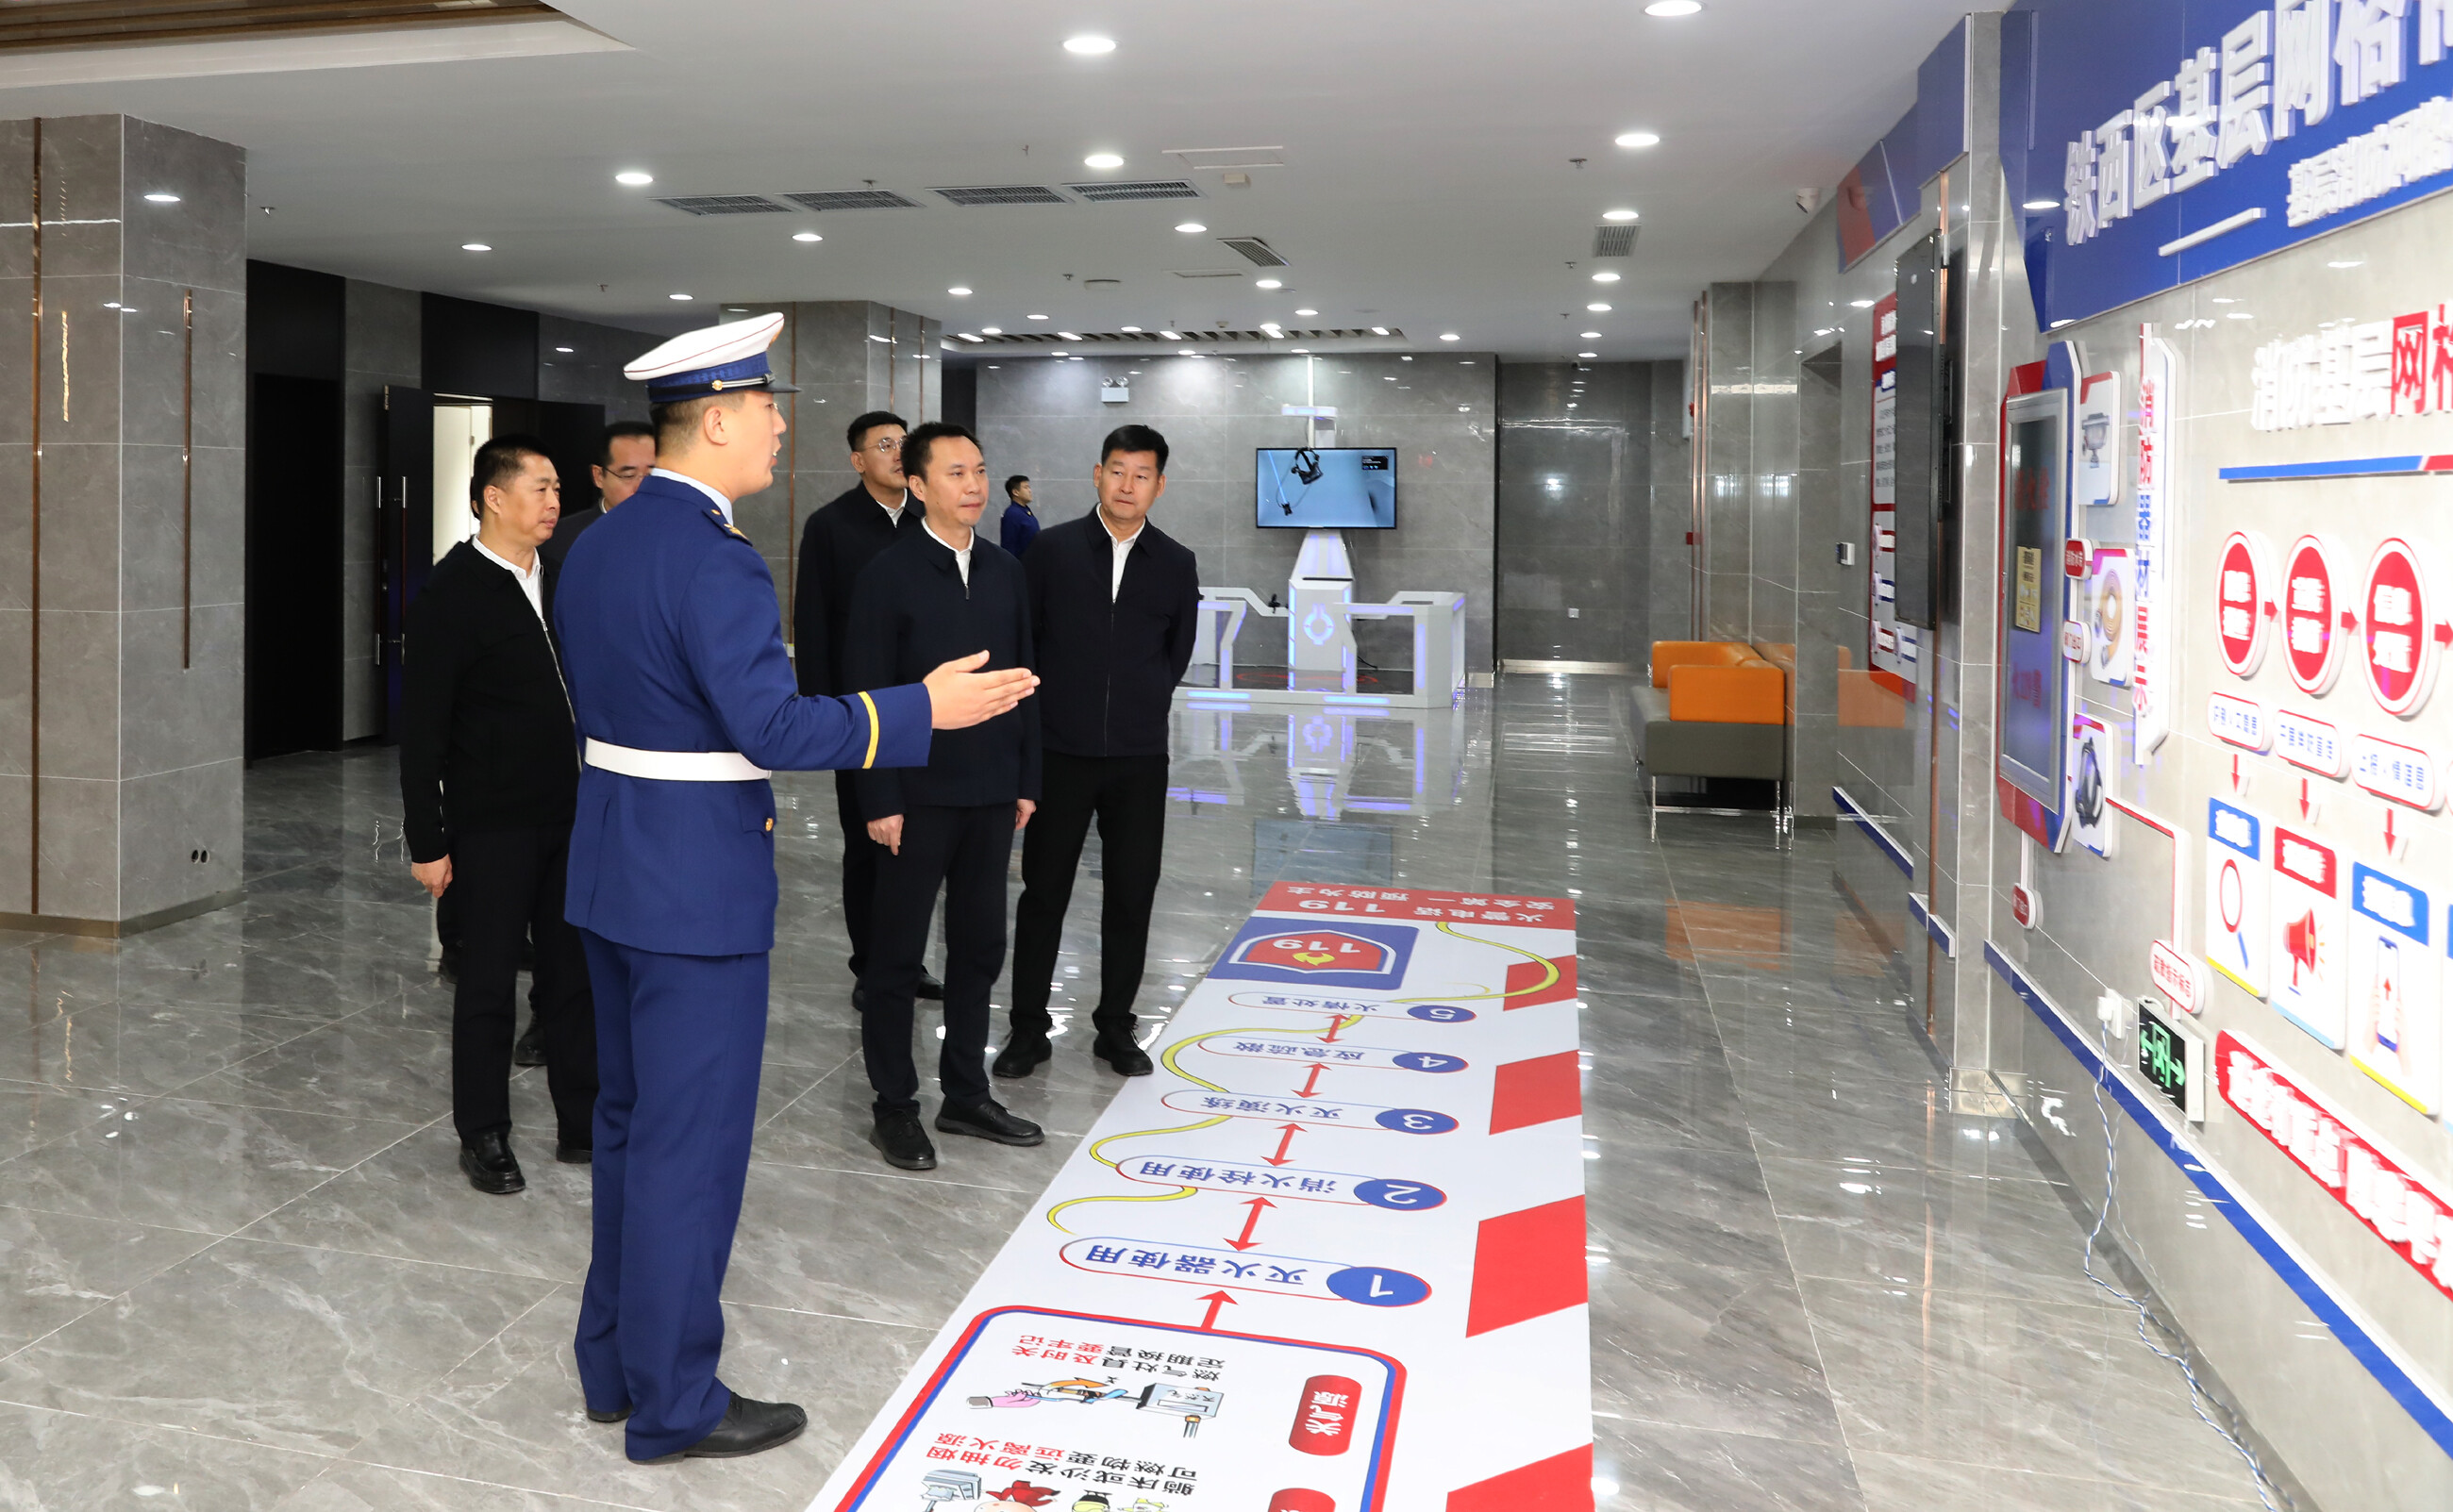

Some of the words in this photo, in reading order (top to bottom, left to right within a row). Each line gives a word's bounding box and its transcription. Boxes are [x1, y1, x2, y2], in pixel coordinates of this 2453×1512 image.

[2064, 0, 2453, 245] 铁西区基层网格
[1287, 886, 1410, 902] 预防为主
[1427, 897, 1555, 911] 安全第一
[1298, 900, 1387, 914] 119
[1414, 906, 1544, 922] 火警电话
[1272, 939, 1361, 954] 119
[1261, 995, 1380, 1013] 火情处置
[1428, 1007, 1457, 1020] 5
[1232, 1040, 1365, 1061] 应急疏散
[1418, 1055, 1449, 1069] 4
[1199, 1095, 1343, 1120] 灭火演练
[1403, 1113, 1435, 1131] 3
[1139, 1161, 1338, 1195] 消火栓使用
[1383, 1183, 1422, 1205] 2
[1085, 1244, 1309, 1287] 灭火器使用
[1369, 1274, 1393, 1298] 1
[1010, 1345, 1221, 1382] 燃气灶具及时关
[1018, 1335, 1226, 1370] 定期换管要牢记
[1304, 1390, 1349, 1437] 关气源
[934, 1433, 1197, 1482] 可燃物要远离火源
[926, 1445, 1195, 1497] 躺床或沙发勿抽烟
